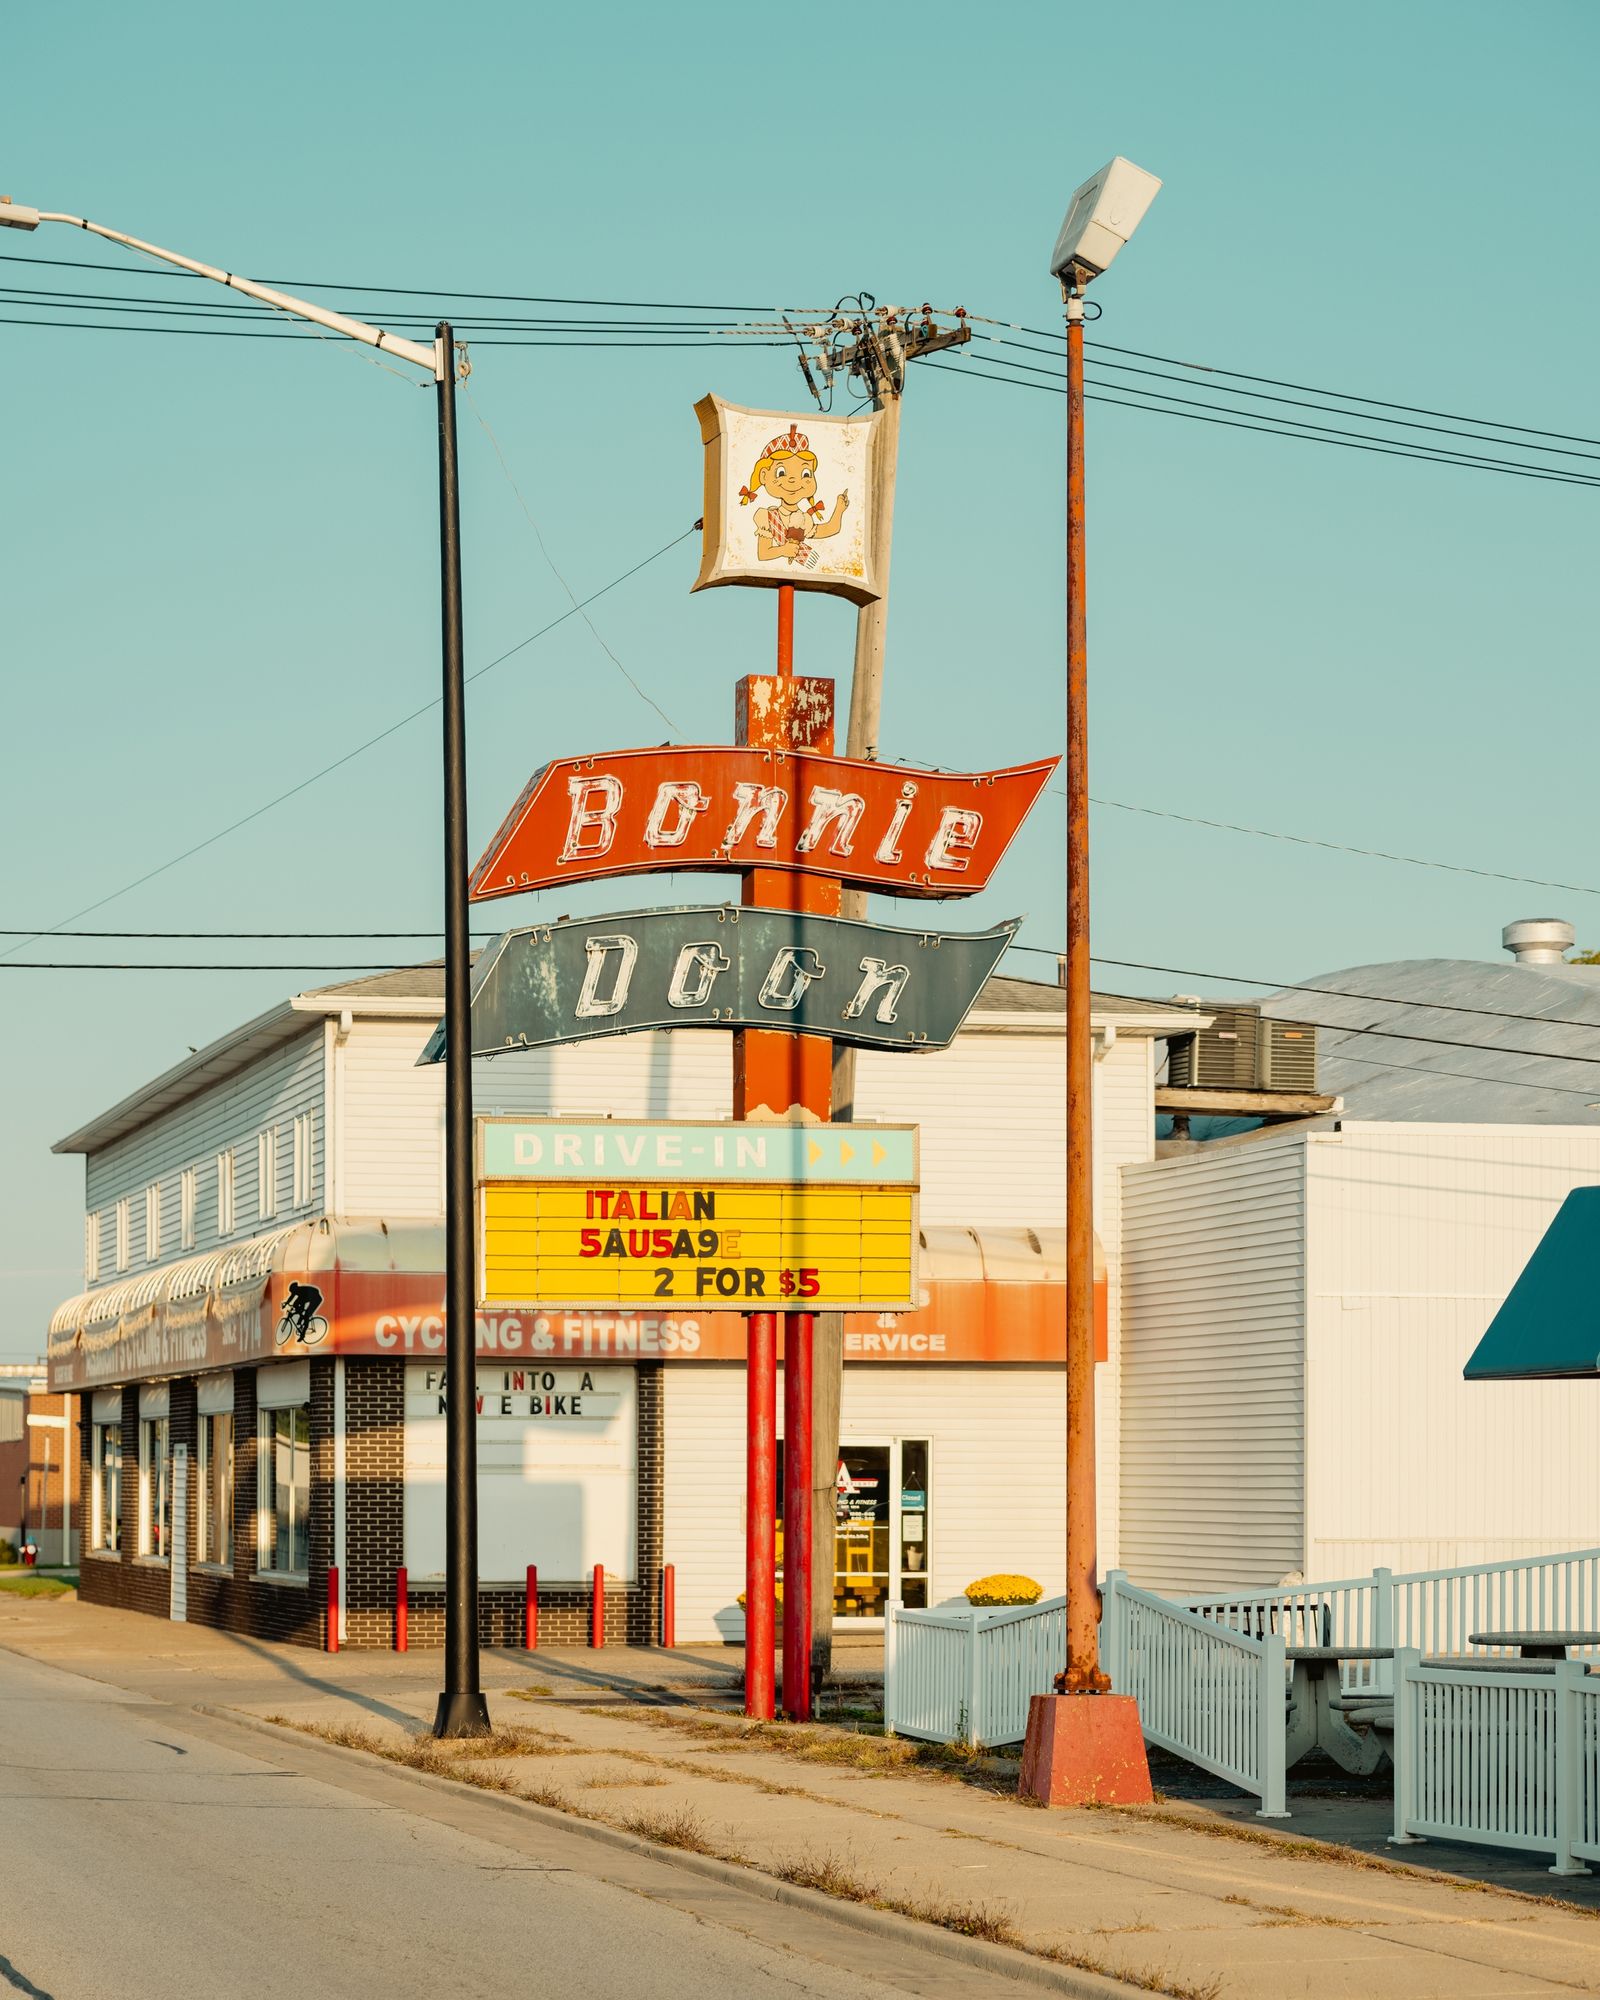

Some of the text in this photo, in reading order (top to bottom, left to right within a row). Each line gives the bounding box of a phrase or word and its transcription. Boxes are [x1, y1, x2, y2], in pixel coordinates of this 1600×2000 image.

[557, 774, 983, 871] Bonnie
[575, 935, 910, 1024] Doon
[513, 1133, 766, 1168] DRIVE-IN
[586, 1190, 715, 1220] ITALIAN
[654, 1267, 820, 1297] 2 FOR $5
[375, 1316, 701, 1352] CYCNG & FITNESS
[845, 1333, 946, 1352] ERVICE
[504, 1371, 555, 1391] INTO
[580, 1371, 593, 1391] A
[501, 1396, 512, 1415] E
[530, 1396, 582, 1415] BIKE
